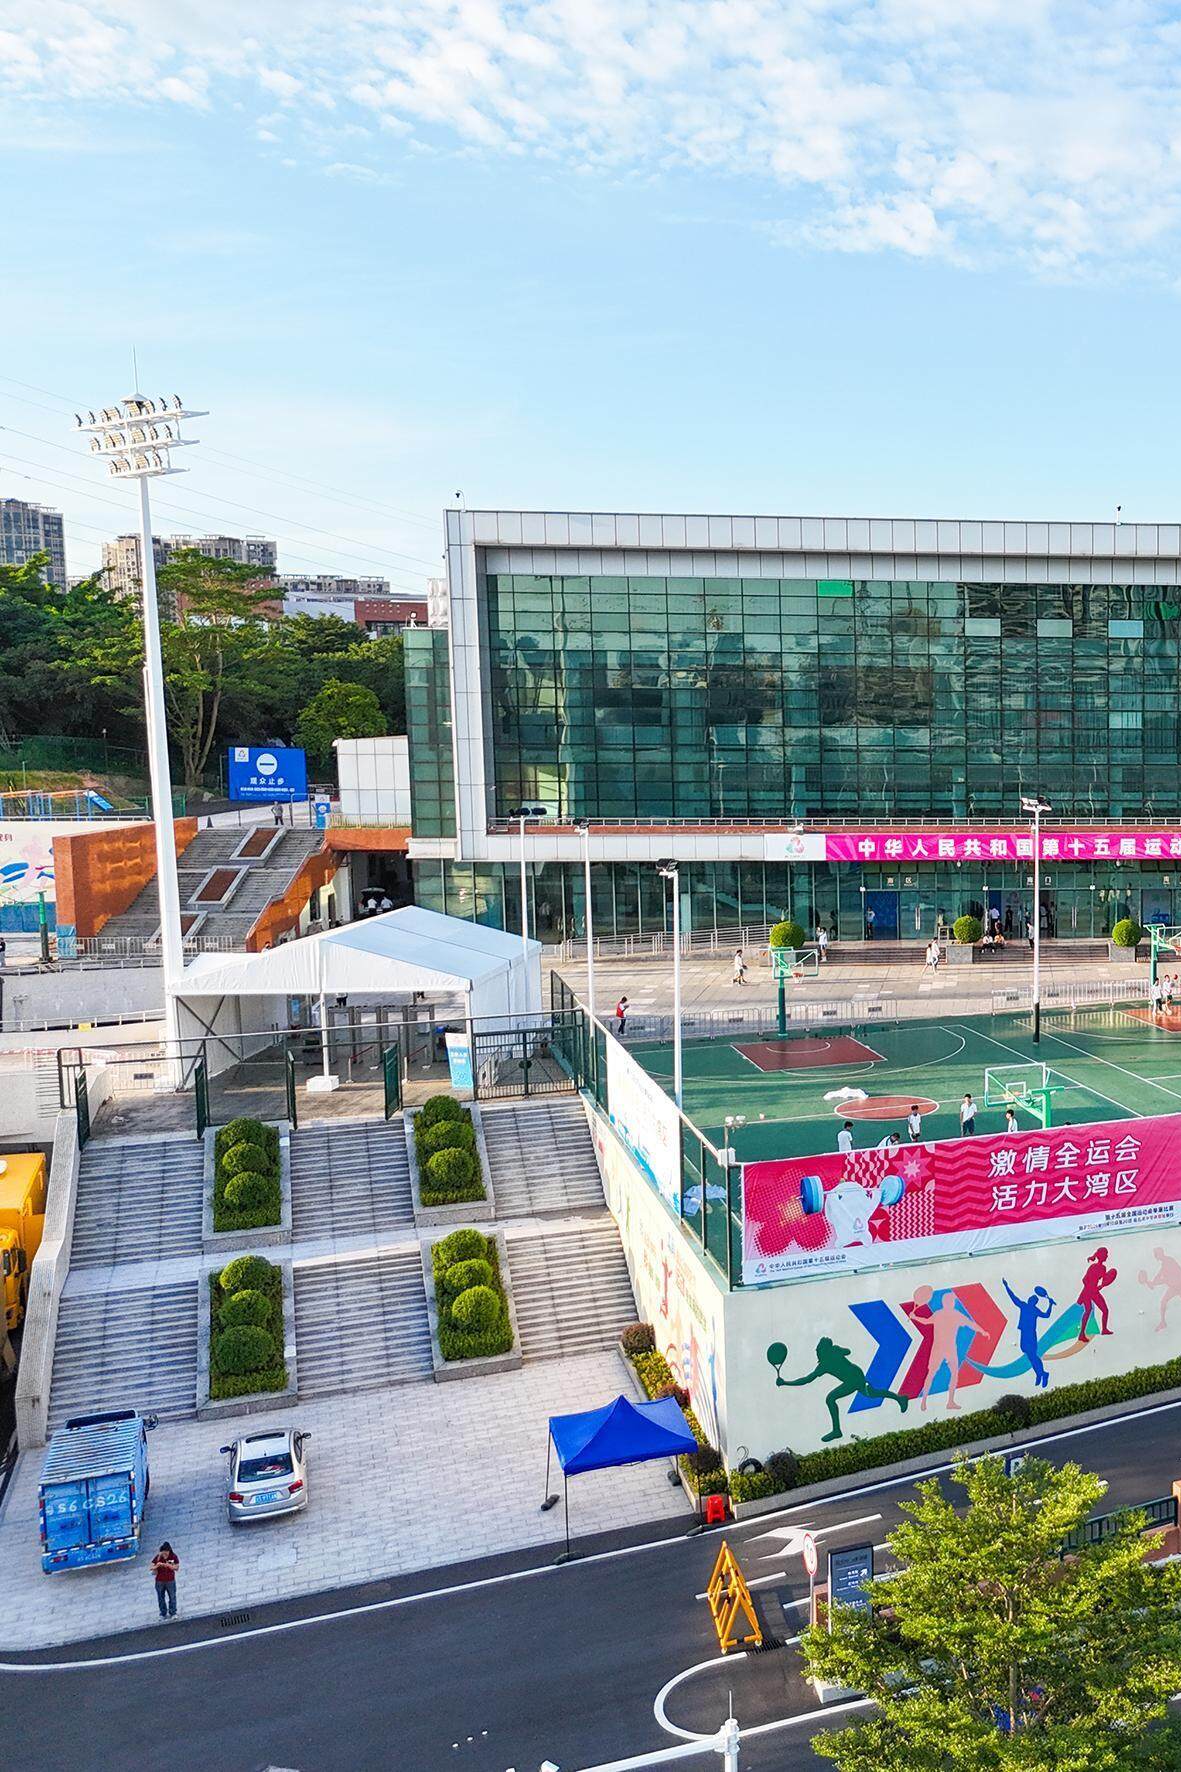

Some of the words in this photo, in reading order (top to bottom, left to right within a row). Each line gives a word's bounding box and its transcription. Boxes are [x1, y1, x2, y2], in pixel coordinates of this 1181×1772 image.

[989, 1134, 1142, 1178] 激情全运会
[990, 1168, 1139, 1212] 活力大湾区
